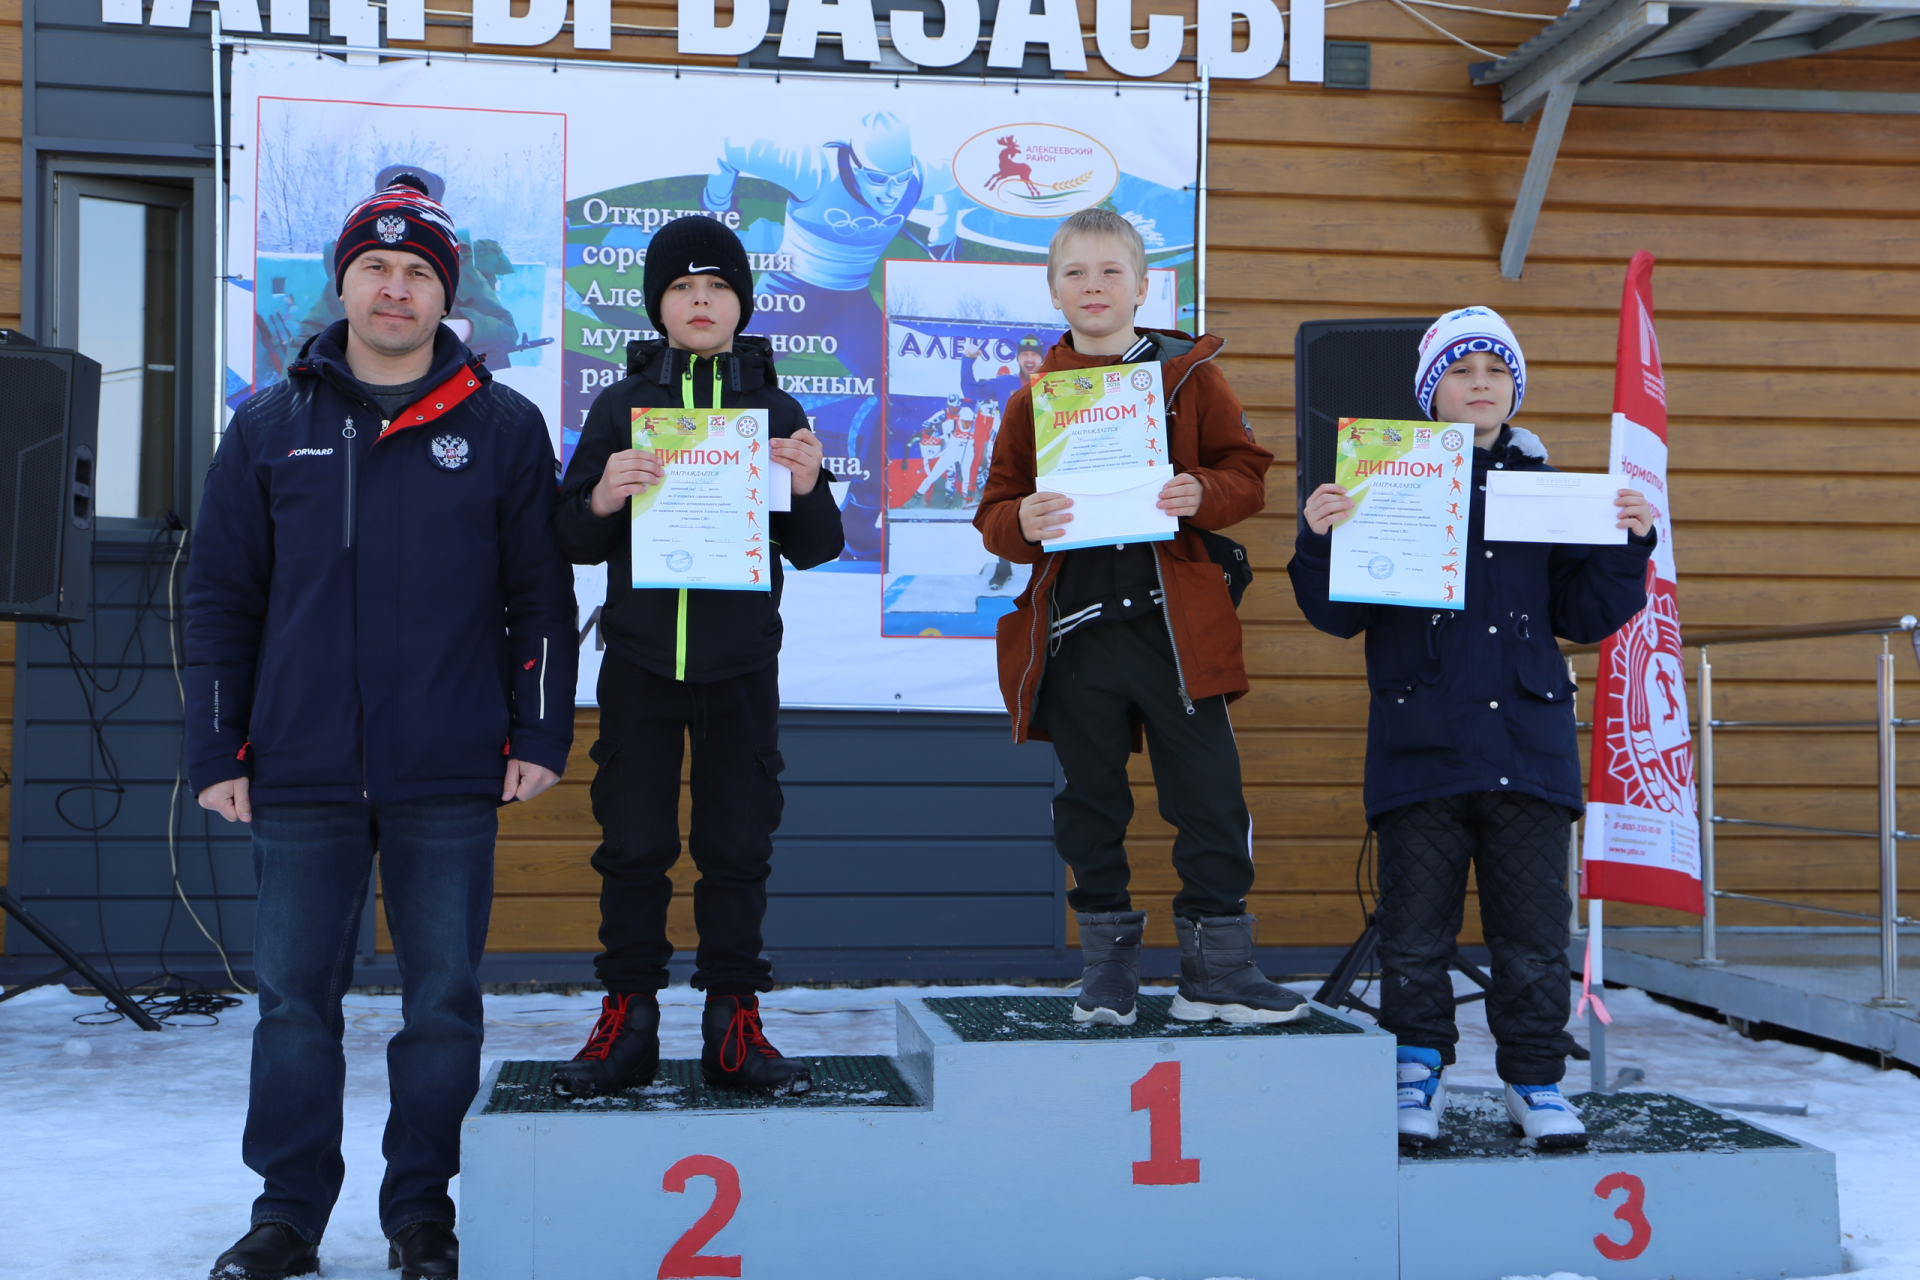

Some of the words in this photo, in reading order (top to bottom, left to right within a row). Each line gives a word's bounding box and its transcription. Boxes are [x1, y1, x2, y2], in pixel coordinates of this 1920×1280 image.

[1026, 145, 1093, 156] АЛЕКСЕЕВСКИЙ
[1026, 153, 1056, 162] РАЙОН
[583, 198, 740, 233] Открые
[1053, 404, 1137, 429] ДИПЛОМ
[654, 448, 740, 467] ДИПЛОМ
[1355, 459, 1444, 478] ДИПЛОМ
[1131, 1062, 1200, 1185] 1
[658, 1155, 742, 1280] 2
[1595, 1172, 1651, 1261] 3
